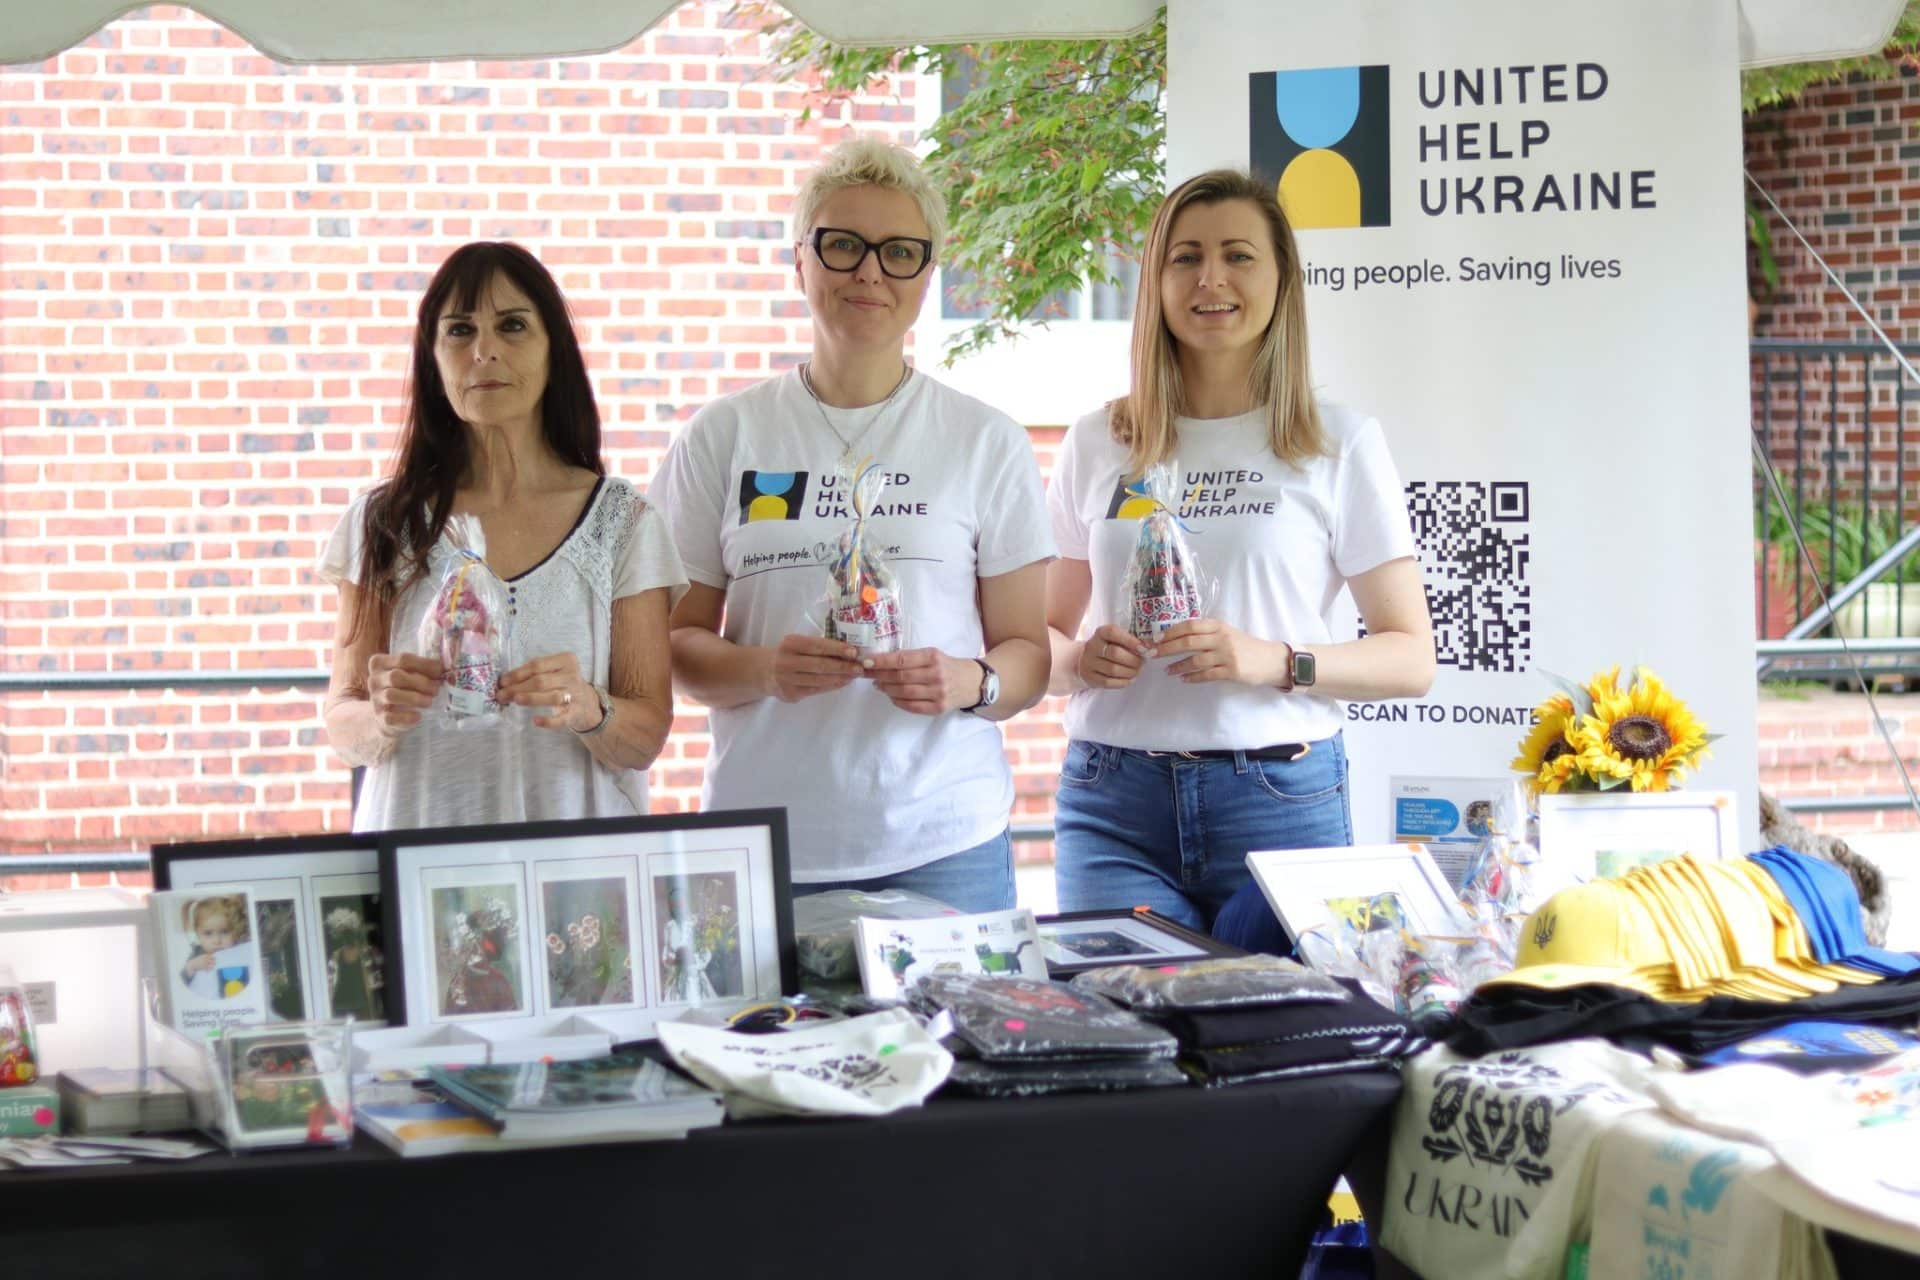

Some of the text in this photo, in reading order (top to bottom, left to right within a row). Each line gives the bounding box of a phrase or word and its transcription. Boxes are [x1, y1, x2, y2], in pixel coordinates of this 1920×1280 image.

[1418, 62, 1609, 109] UNITED
[1418, 120, 1551, 163] HELP
[1419, 170, 1658, 217] UKRAINE
[1303, 254, 1622, 292] ing people. Saving lives
[1186, 470, 1264, 486] UNITED
[1182, 488, 1237, 502] HELP
[814, 503, 928, 519] UKAINE
[1178, 502, 1275, 518] UKRAINE
[742, 551, 777, 570] Helping
[778, 547, 811, 566] people.
[1347, 703, 1542, 726] SCAN TO DONATE
